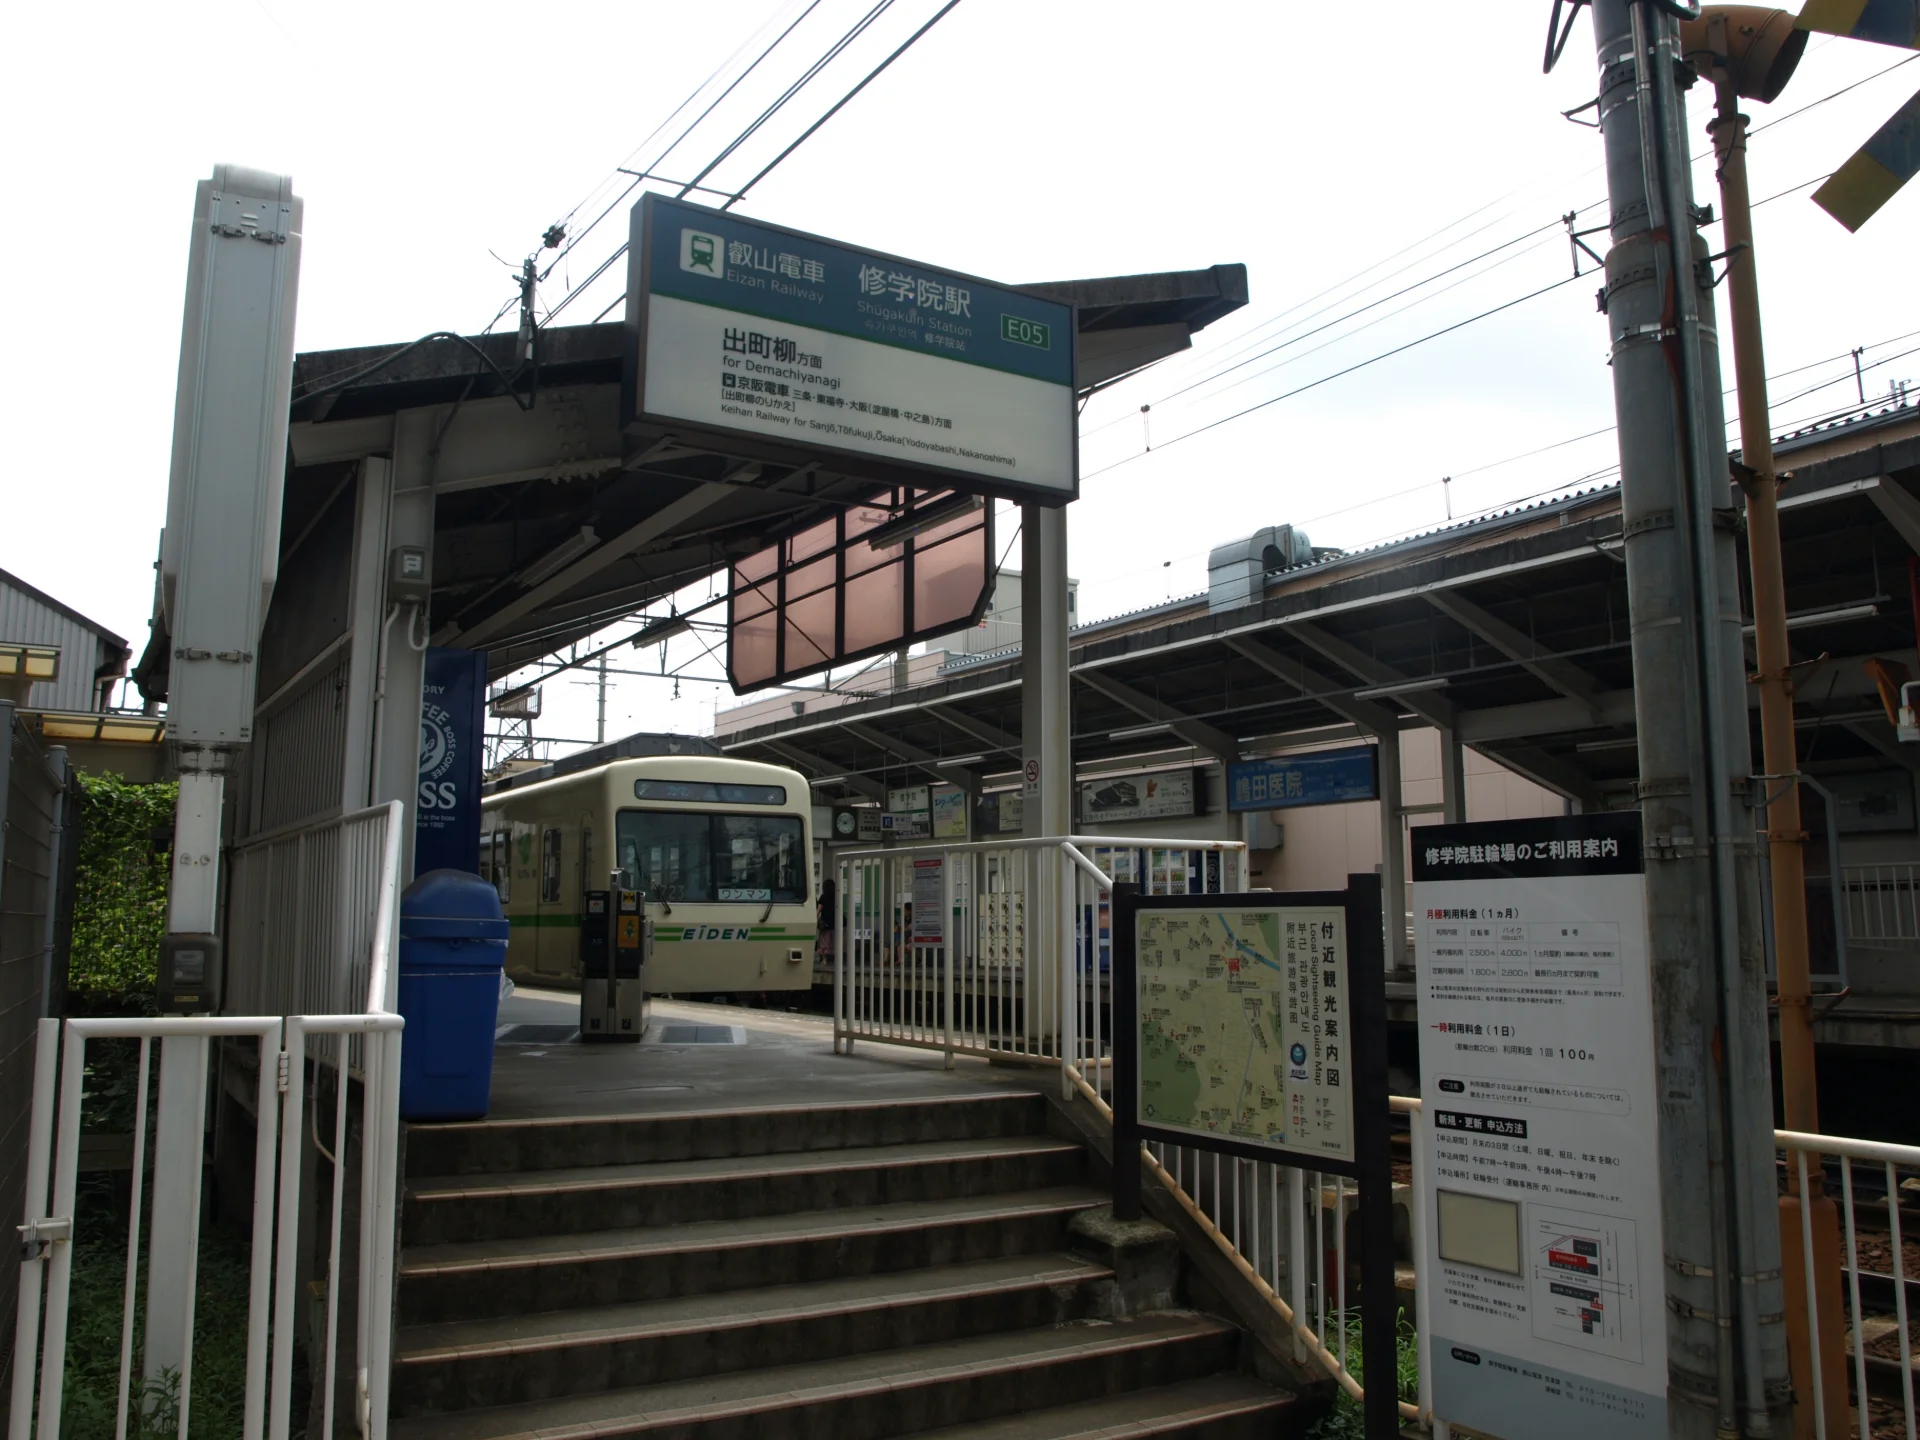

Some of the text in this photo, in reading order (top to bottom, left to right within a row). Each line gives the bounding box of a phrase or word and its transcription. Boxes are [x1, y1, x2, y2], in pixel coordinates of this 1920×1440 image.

[728, 240, 826, 284] 叡山電車
[727, 268, 825, 304] Eizan Railway
[858, 264, 971, 318] 修学院駅
[857, 300, 972, 337] Shūgakuin Station
[1008, 319, 1044, 345] E05
[722, 327, 823, 369] 出町柳方面
[723, 355, 842, 390] for Demachiyanagi
[737, 376, 790, 398] 京阪電車
[721, 404, 753, 417] Keihan
[755, 409, 791, 425] Railway
[793, 416, 807, 427] for
[430, 725, 457, 780] BOSS COFFEE
[1425, 837, 1619, 866] 修学院駐輪場のご利用案内
[721, 889, 768, 900] ワンマン
[1309, 923, 1323, 1086] Local Sightseeing Guide Map
[1321, 921, 1340, 1087] 付近観光案内図
[1502, 1044, 1533, 1056] 利用料金
[1486, 1120, 1524, 1135] 申込方法
